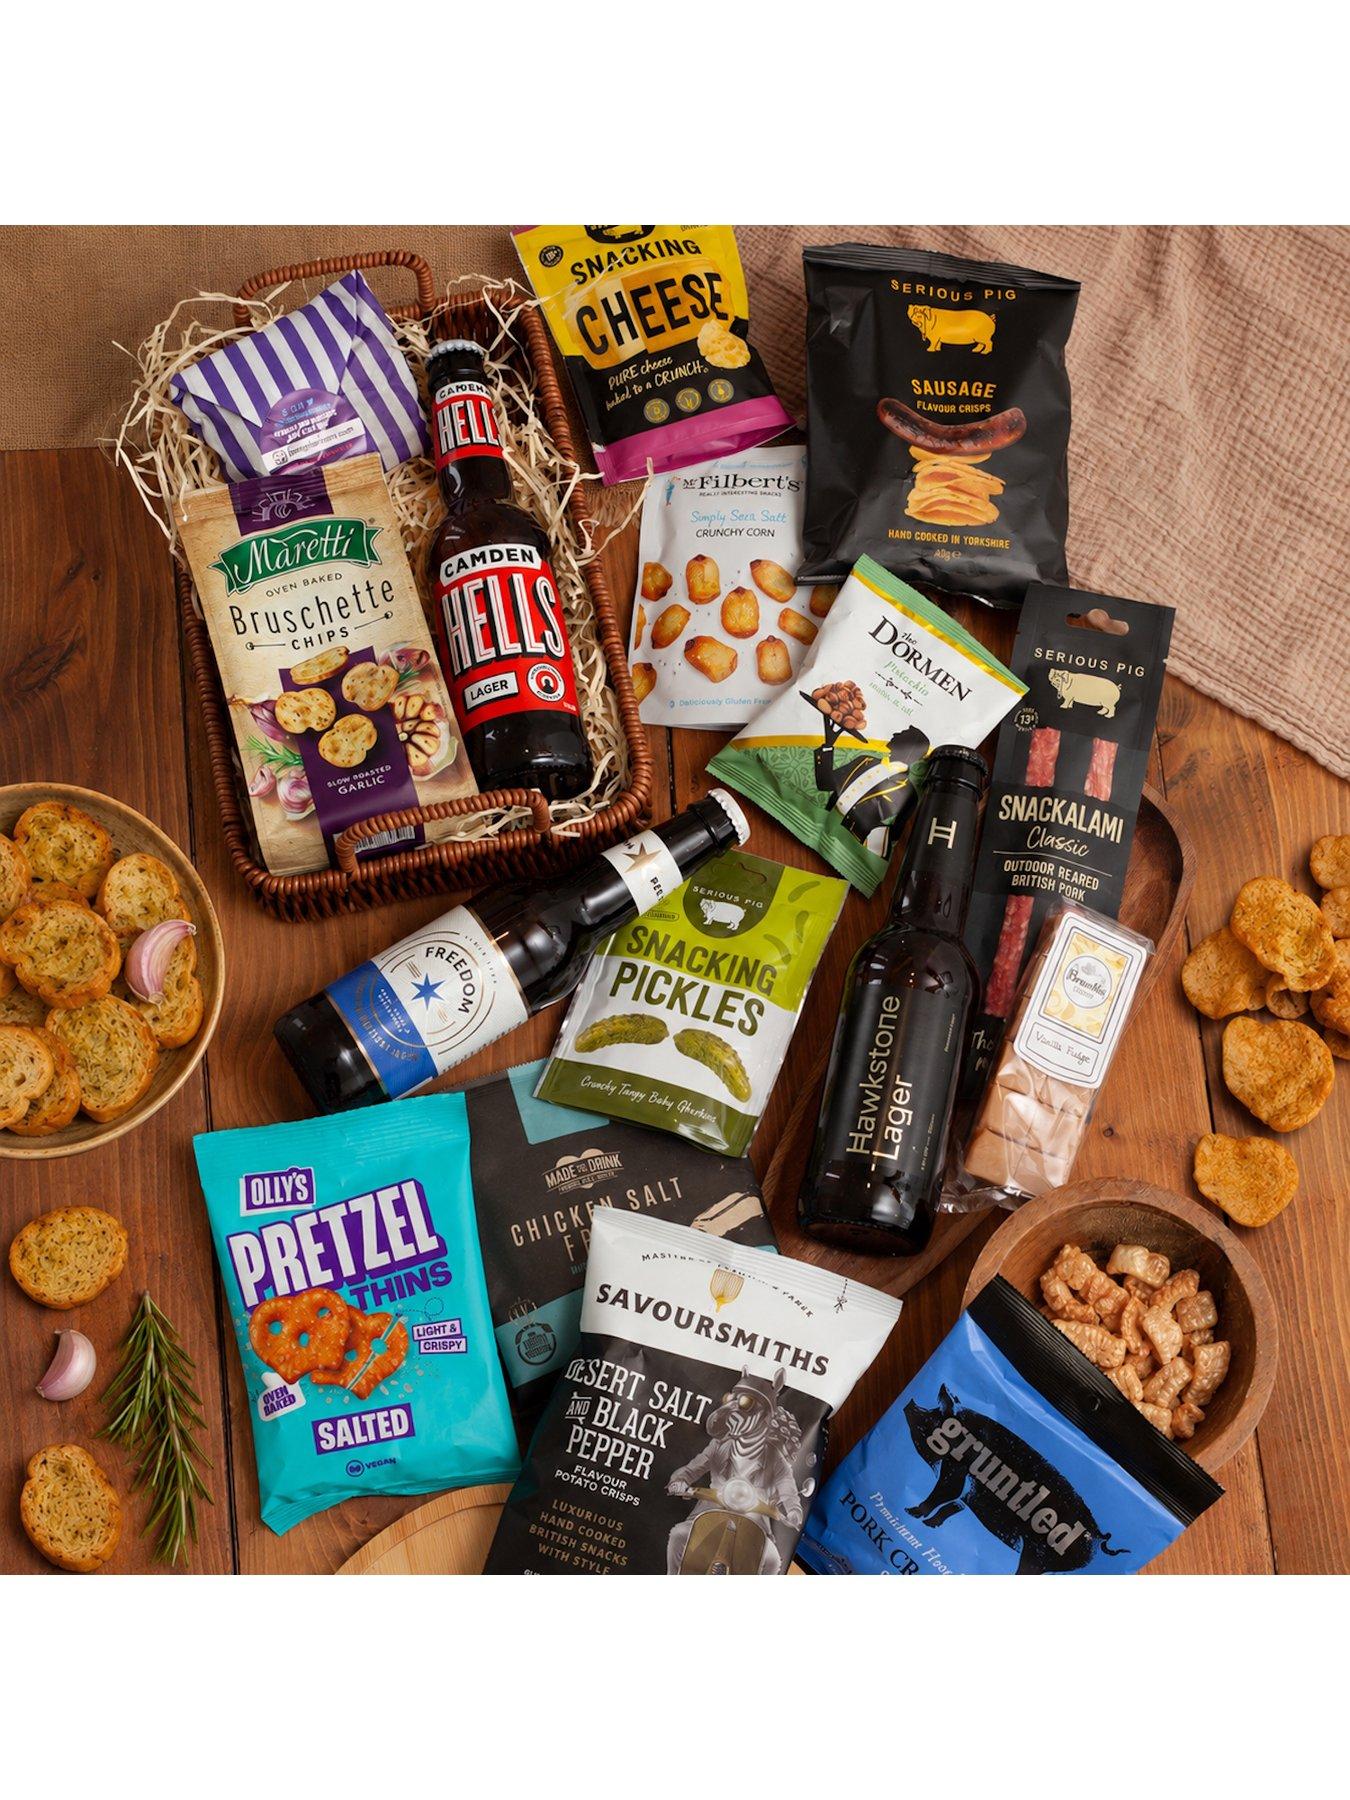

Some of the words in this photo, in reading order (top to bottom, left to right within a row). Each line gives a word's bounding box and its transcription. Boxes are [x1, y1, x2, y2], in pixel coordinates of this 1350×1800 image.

[570, 238, 702, 285] SNACKING
[890, 279, 974, 302] SERIOUS
[984, 289, 1017, 300] PIG
[576, 272, 728, 356] CHEESE
[608, 367, 639, 391] PURE
[640, 356, 673, 374] cheese
[911, 379, 998, 399] SAUSAGE
[916, 400, 957, 414] FLAVOUR
[959, 404, 992, 414] CRISPS
[437, 400, 500, 455] HELL
[699, 474, 801, 492] Filbert's
[690, 511, 727, 527] Simply
[696, 527, 745, 538] CRUNCHY
[746, 528, 776, 538] CORN
[888, 529, 912, 540] HAND
[914, 531, 949, 543] COOKED
[951, 535, 961, 544] IN
[963, 535, 1011, 550] YORKSHIRE
[444, 548, 535, 578] CAMDEN
[266, 581, 297, 597] OVEN
[303, 572, 343, 587] BAKED
[229, 580, 395, 636] Bruschette
[442, 573, 566, 677] HELLS
[291, 626, 349, 650] CHIPS
[868, 616, 973, 702] DORMEN
[1034, 647, 1109, 671] SERIOUS
[1116, 663, 1145, 678] PIG
[470, 678, 509, 701] LAGER
[337, 774, 386, 796] GARLIC
[928, 817, 957, 849] H
[998, 794, 1124, 844] SNACKALAMI
[1026, 825, 1090, 857] Classic
[1003, 860, 1055, 875] OUTDOOR
[1058, 865, 1099, 891] REARED
[1011, 875, 1056, 892] BRITISH
[1058, 883, 1086, 902] PORK
[692, 885, 740, 903] SERIOUS
[744, 897, 764, 909] PIG
[626, 926, 777, 997] SNACKING
[425, 946, 475, 1015] FREEDOM
[609, 961, 765, 1037] PICKLES
[1066, 1045, 1091, 1065] Fudge
[846, 995, 900, 1155] Hawkstone
[581, 1075, 617, 1095] Crunchy
[619, 1083, 645, 1103] Tangy
[648, 1090, 675, 1111] Baby
[872, 1074, 913, 1162] Lager
[545, 1163, 578, 1188] MADE
[588, 1153, 623, 1172] DRINK
[251, 1171, 309, 1206] OLLY'S
[510, 1194, 615, 1248] CHICKEN
[625, 1177, 684, 1211] SALT
[228, 1180, 439, 1309] PRETZEL
[350, 1261, 453, 1311] THINS
[449, 1323, 457, 1333] &
[596, 1283, 830, 1376] SAVOURSMITHS
[423, 1340, 463, 1352] CRISPY
[262, 1385, 290, 1405] OVEN
[264, 1394, 297, 1417] BAKED
[565, 1358, 646, 1401] DESERT
[648, 1380, 713, 1424] SALT
[317, 1408, 409, 1450] SALTED
[566, 1400, 591, 1416] AND
[591, 1396, 674, 1449] BLACK
[364, 1457, 397, 1469] VEGAN
[565, 1424, 655, 1480] PEPPER
[554, 1469, 598, 1491] POTATO
[600, 1485, 641, 1507] CRISPS
[573, 1464, 628, 1490] FLAVOUR
[926, 1417, 1083, 1557] gruntled
[540, 1511, 575, 1531] HAND
[578, 1525, 627, 1549] COOKED
[552, 1499, 624, 1532] LUXURIOUS
[838, 1488, 894, 1553] PORK
[529, 1524, 577, 1548] BRITISH
[580, 1542, 629, 1566] SNACKS
[538, 1543, 570, 1564] WITH
[572, 1555, 611, 1575] STYLE
